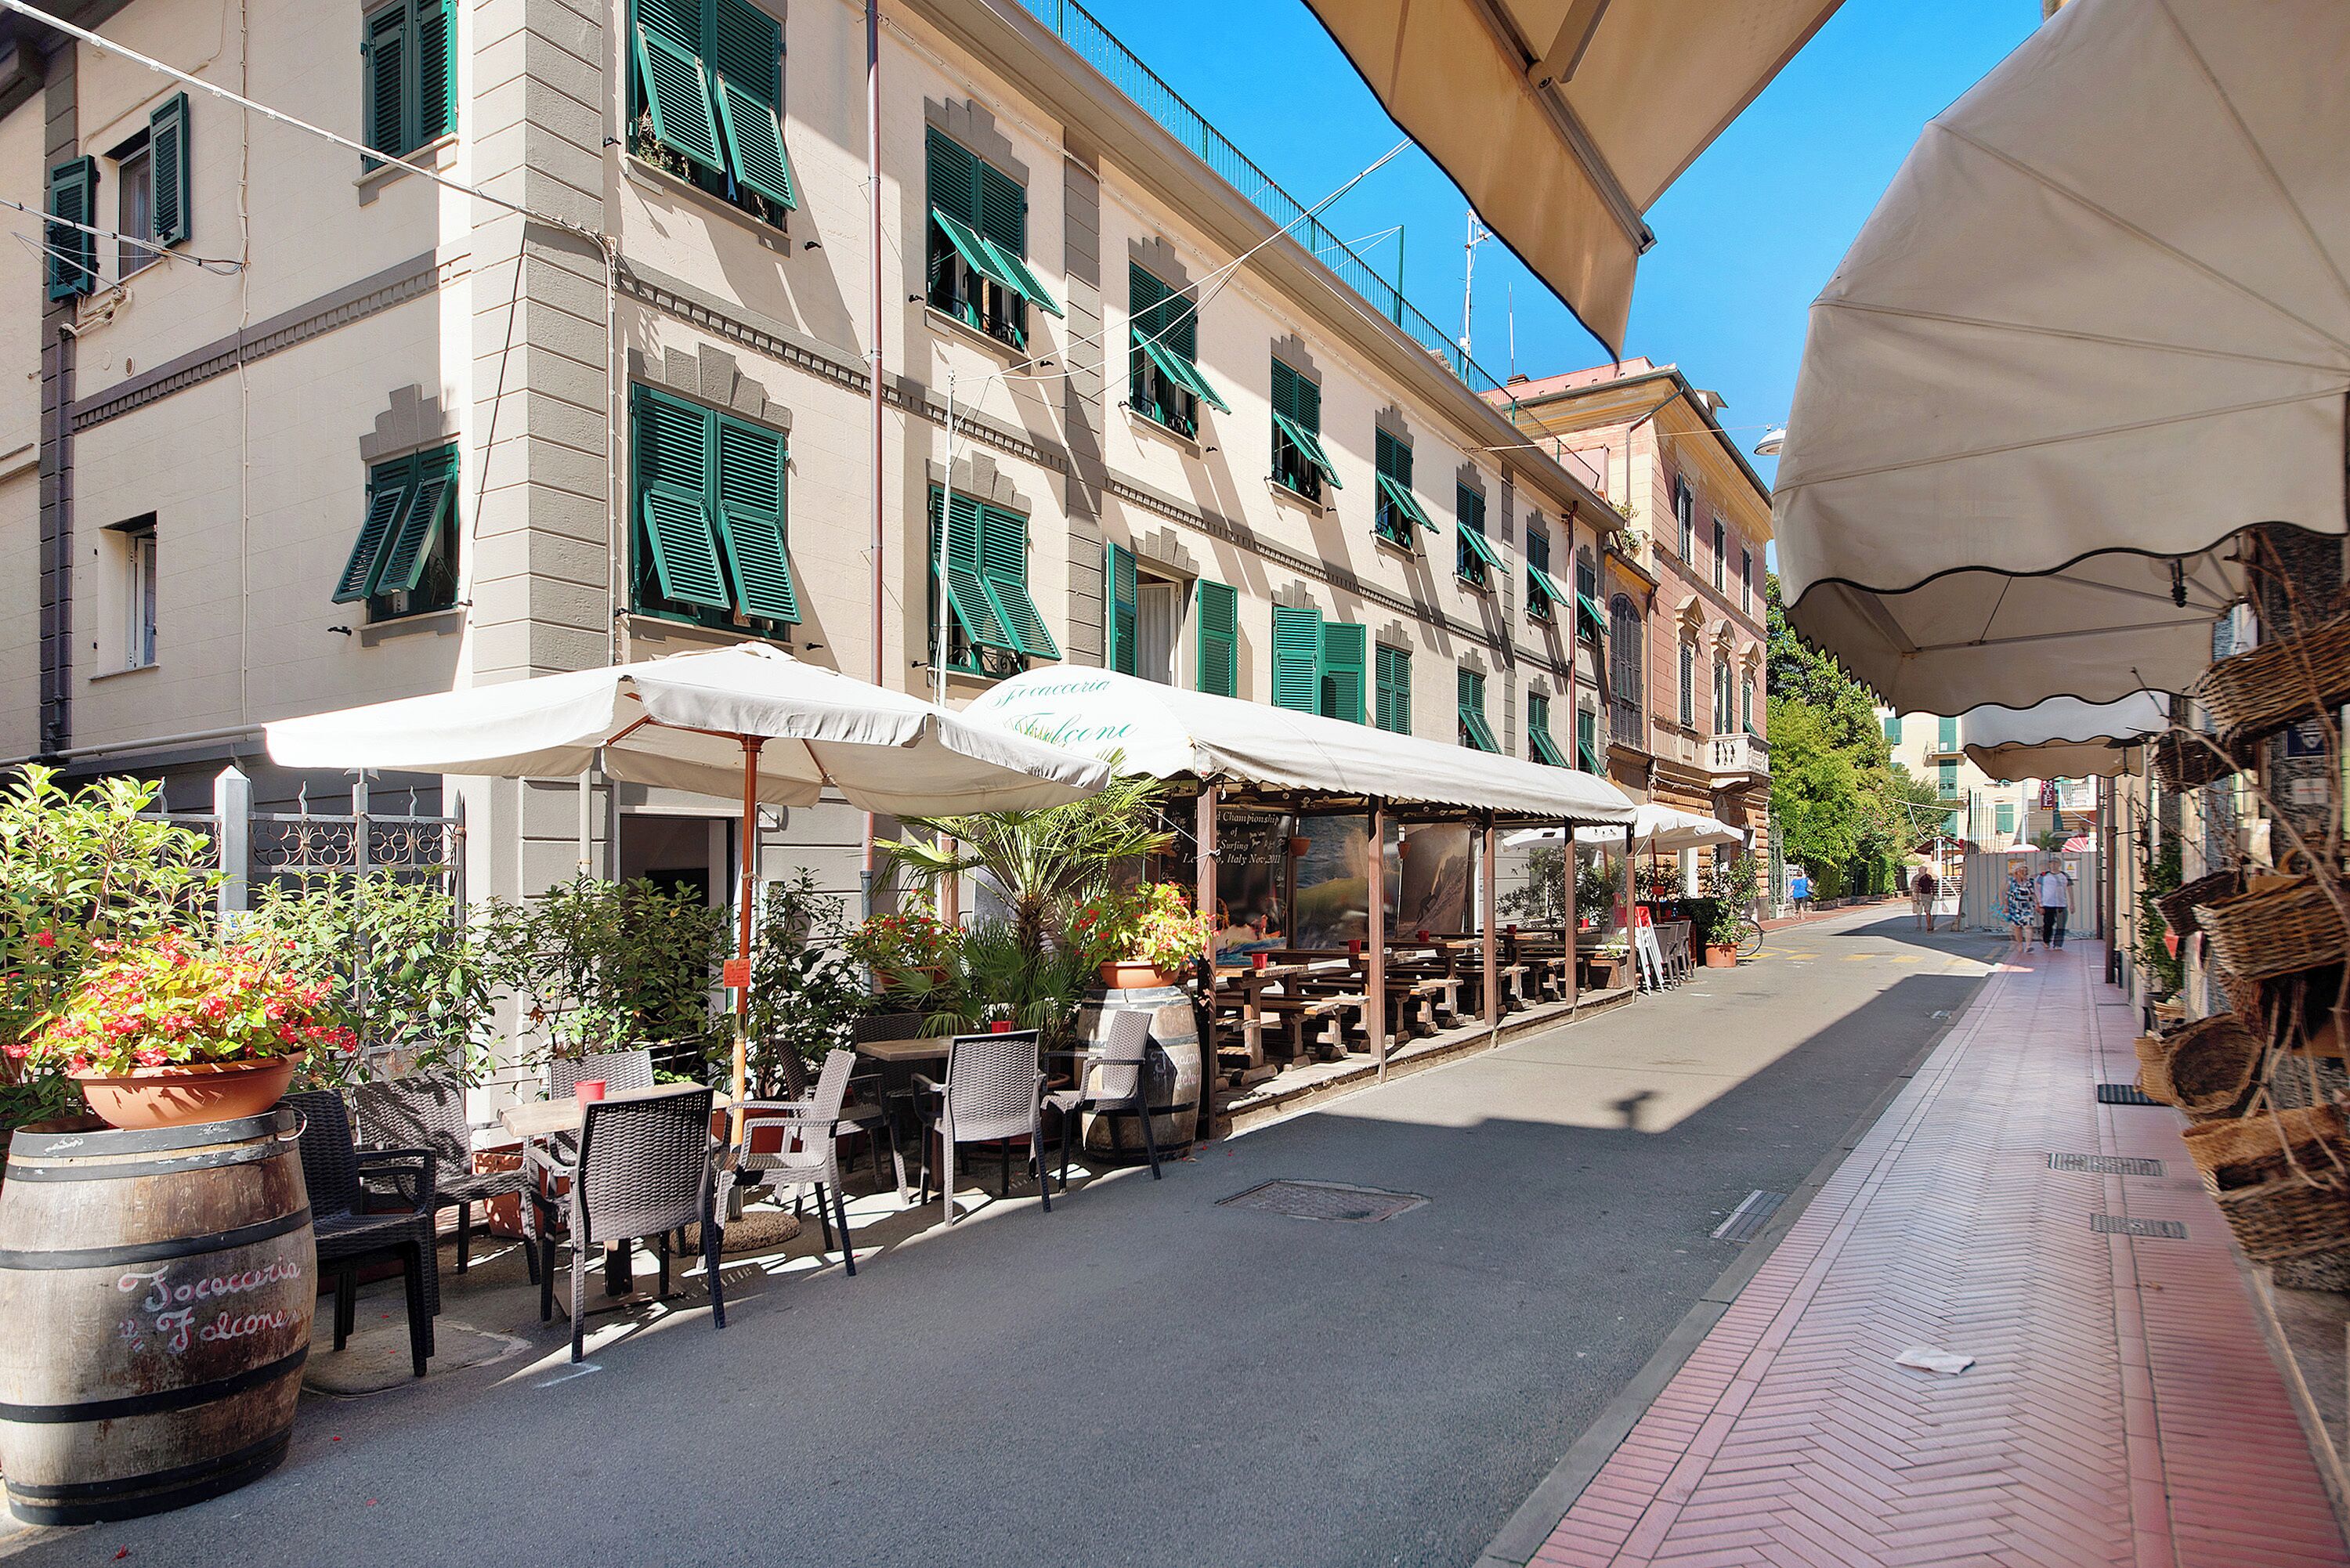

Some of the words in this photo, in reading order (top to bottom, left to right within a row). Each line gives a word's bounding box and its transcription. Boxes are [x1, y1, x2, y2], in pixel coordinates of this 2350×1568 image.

[987, 679, 1111, 710] Focacceria
[1223, 811, 1279, 826] Championship
[1230, 827, 1238, 836] of
[1220, 839, 1249, 851] Surfing
[1227, 853, 1247, 865] Italy
[118, 1255, 301, 1312] Focacceria
